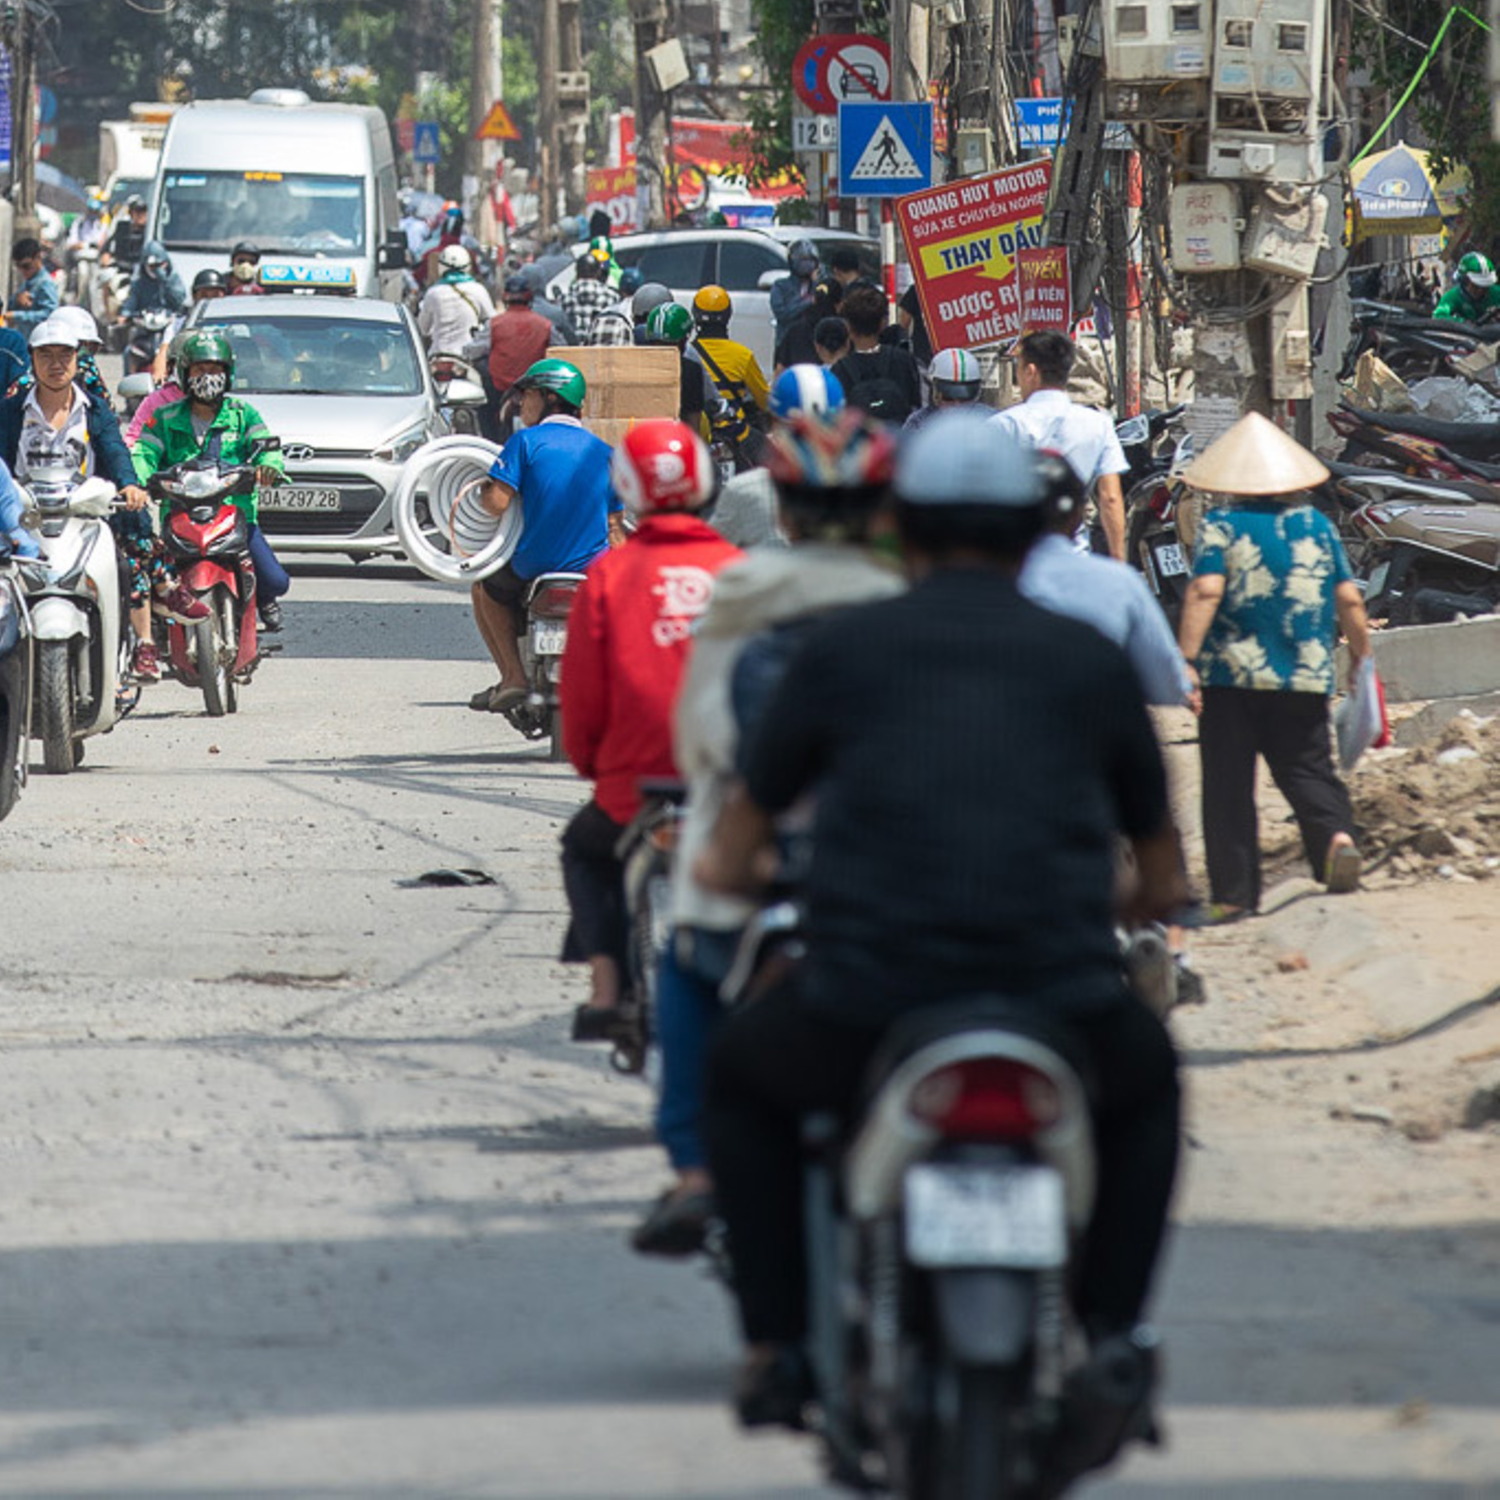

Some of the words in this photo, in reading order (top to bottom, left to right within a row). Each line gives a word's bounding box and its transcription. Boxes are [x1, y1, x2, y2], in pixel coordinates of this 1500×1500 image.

[908, 194, 960, 220] QUANG
[961, 183, 991, 204] HUY
[993, 168, 1048, 196] MOTOR
[941, 215, 957, 231] XE
[940, 237, 992, 270] THAY
[258, 490, 337, 508] 0A-297.28
